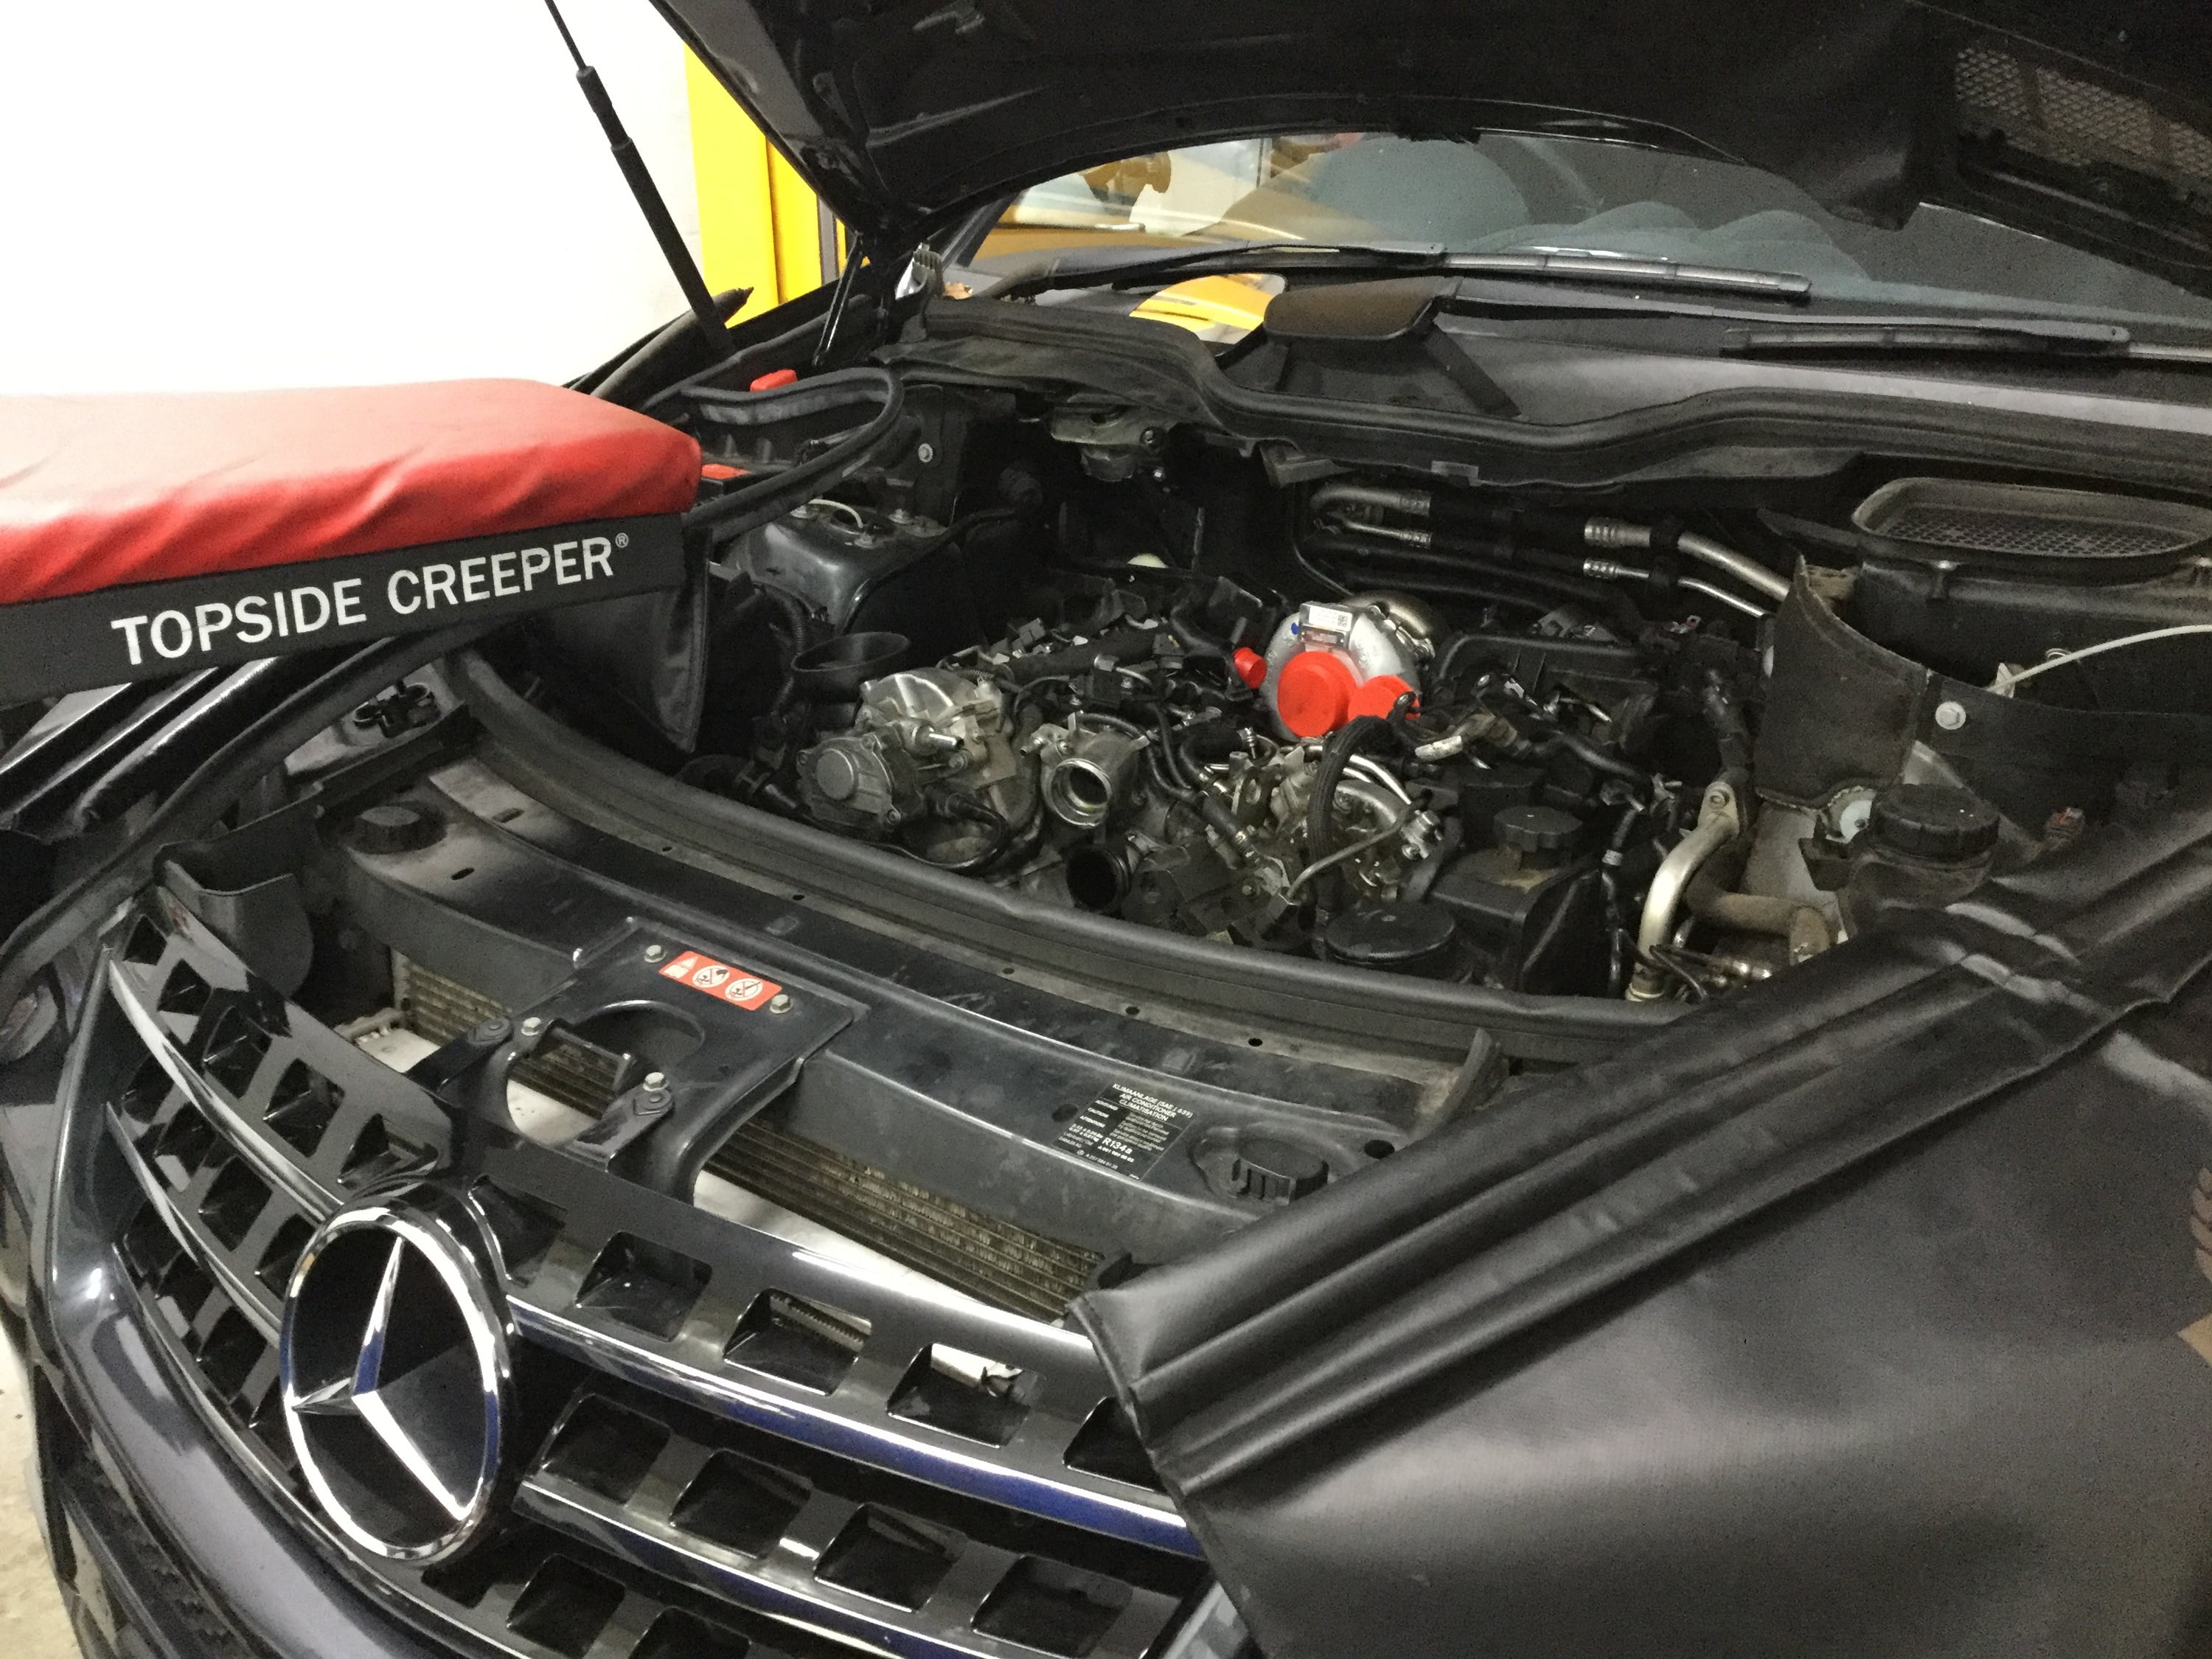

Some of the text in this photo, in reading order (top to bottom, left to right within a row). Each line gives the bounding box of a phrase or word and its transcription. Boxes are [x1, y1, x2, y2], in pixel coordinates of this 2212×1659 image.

[111, 578, 367, 664] TOPSIDE
[1112, 1083, 1158, 1104] KLIMAANLAGE
[1119, 1093, 1177, 1119] AIR CONDITIONER
[1119, 1099, 1169, 1121] CLIMATISATION
[1102, 1137, 1133, 1155] R134a
